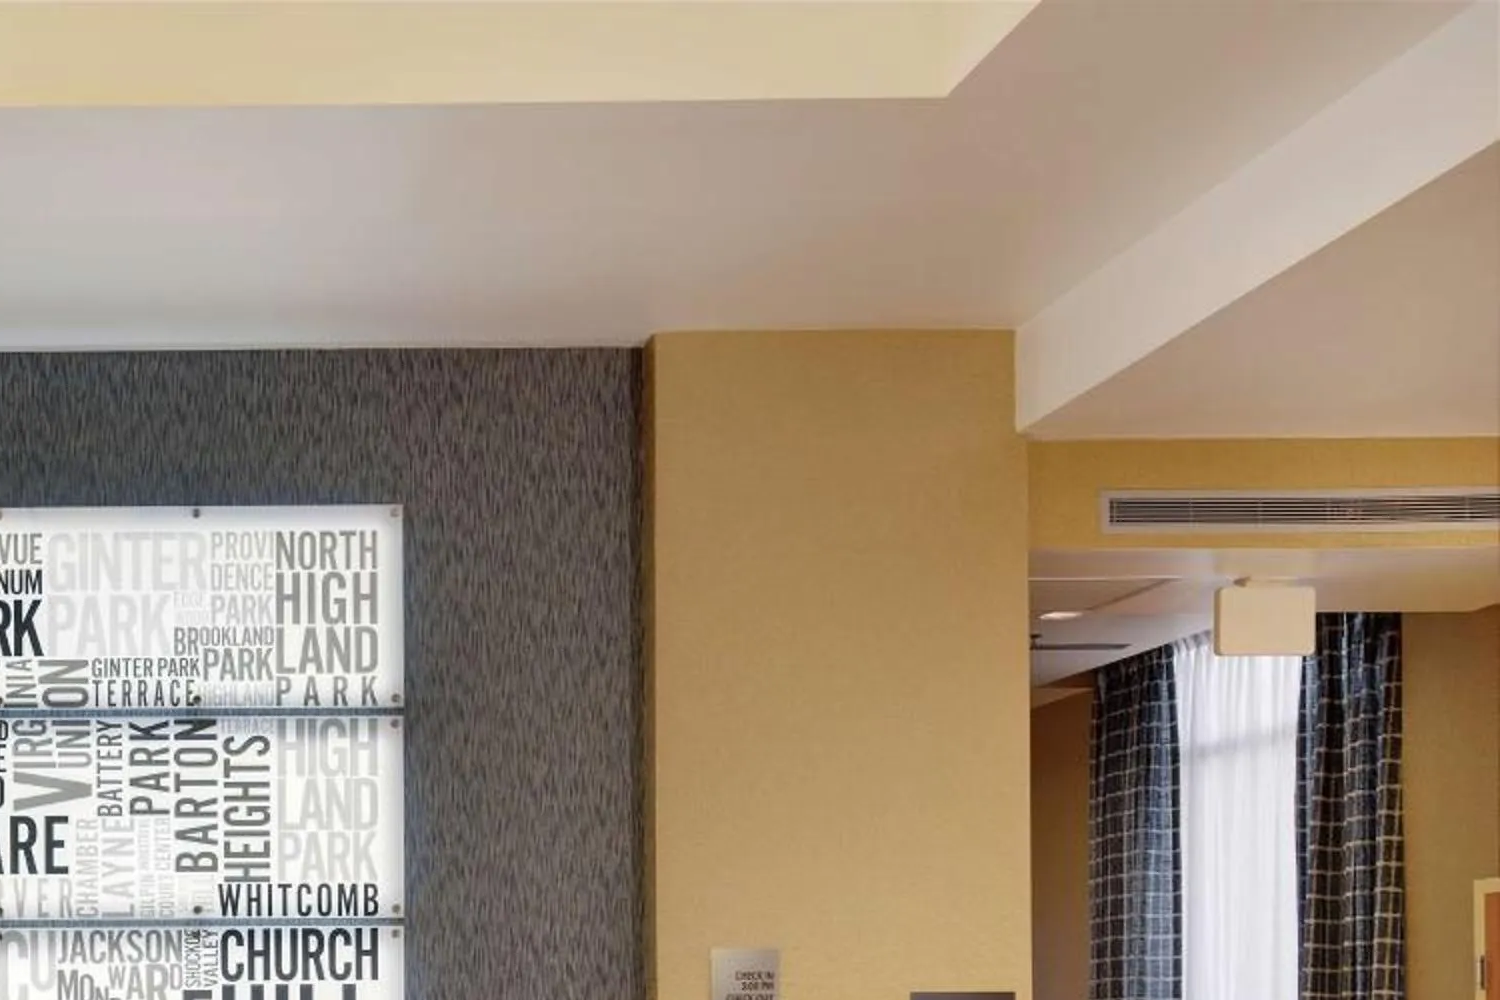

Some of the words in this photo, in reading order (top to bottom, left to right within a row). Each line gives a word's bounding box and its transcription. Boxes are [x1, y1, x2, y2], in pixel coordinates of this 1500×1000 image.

[49, 532, 207, 590] GINTER
[212, 532, 273, 561] PROVI
[276, 531, 377, 570] NORTH
[212, 563, 273, 591] DENCE
[276, 573, 377, 624] HIGH
[49, 595, 173, 656] PARK
[212, 595, 273, 625] PARK
[175, 626, 274, 655] BROOKLAND
[203, 648, 274, 681] PARK
[276, 627, 378, 674] LAND
[93, 657, 153, 677] GINTER
[157, 657, 199, 677] PARK
[276, 676, 378, 706] PARK
[93, 680, 195, 707] TERRACE
[98, 721, 122, 816] BATTERY
[129, 721, 170, 815] PARK
[276, 720, 377, 775] HIGH
[174, 720, 218, 872] BARTON
[223, 735, 271, 882] HEIGHTS
[277, 778, 378, 830] LAND
[76, 818, 98, 917] CHAMBER
[102, 817, 134, 917] LAYNE
[278, 831, 378, 880] PARK
[219, 884, 379, 917] WHITCOMB
[58, 930, 182, 964] JACKSON
[201, 929, 218, 987] VALLEY
[221, 929, 379, 981] CHURCH
[735, 971, 763, 980] CHECK
